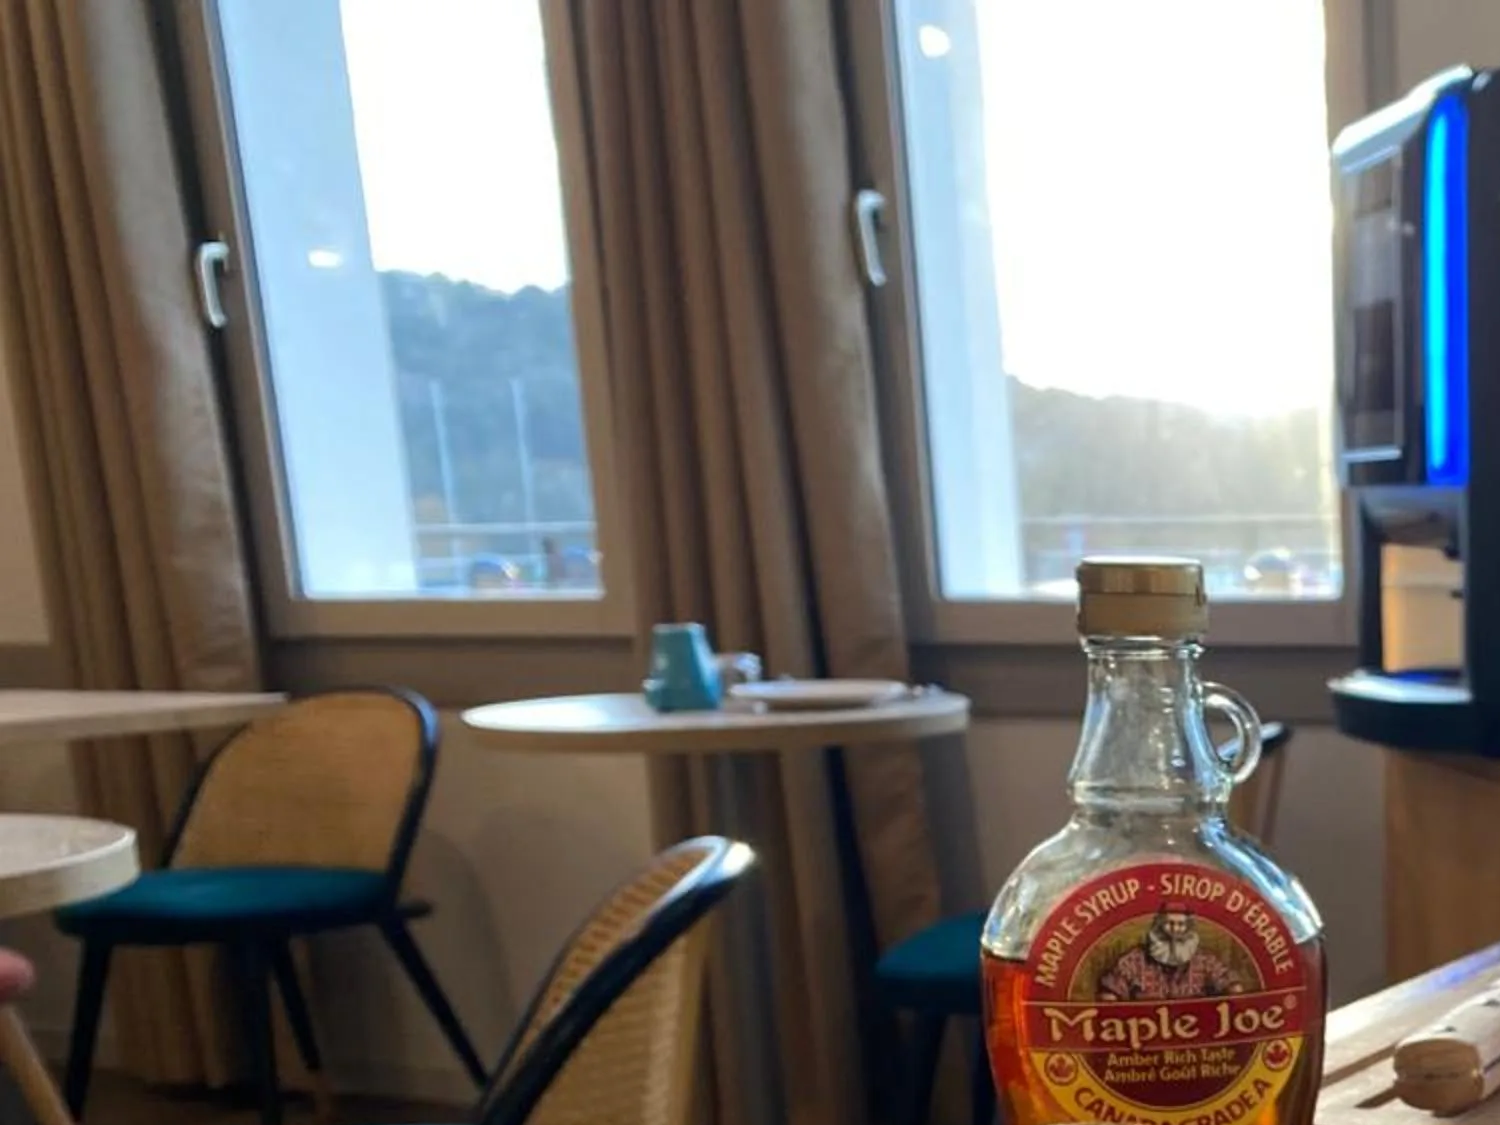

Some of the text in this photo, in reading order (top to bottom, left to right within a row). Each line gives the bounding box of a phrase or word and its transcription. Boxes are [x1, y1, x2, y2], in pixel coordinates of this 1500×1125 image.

[1035, 919, 1079, 987] MAPLE
[1077, 877, 1140, 924] SYRUP
[1160, 873, 1225, 900] SIROP
[1226, 891, 1294, 974] D'ÉRABLE
[1043, 1007, 1199, 1049] Maple
[1107, 1047, 1236, 1067] Amber Rich Taste
[1104, 1063, 1241, 1083] Ambré Goût Riche
[1253, 1078, 1273, 1098] A
